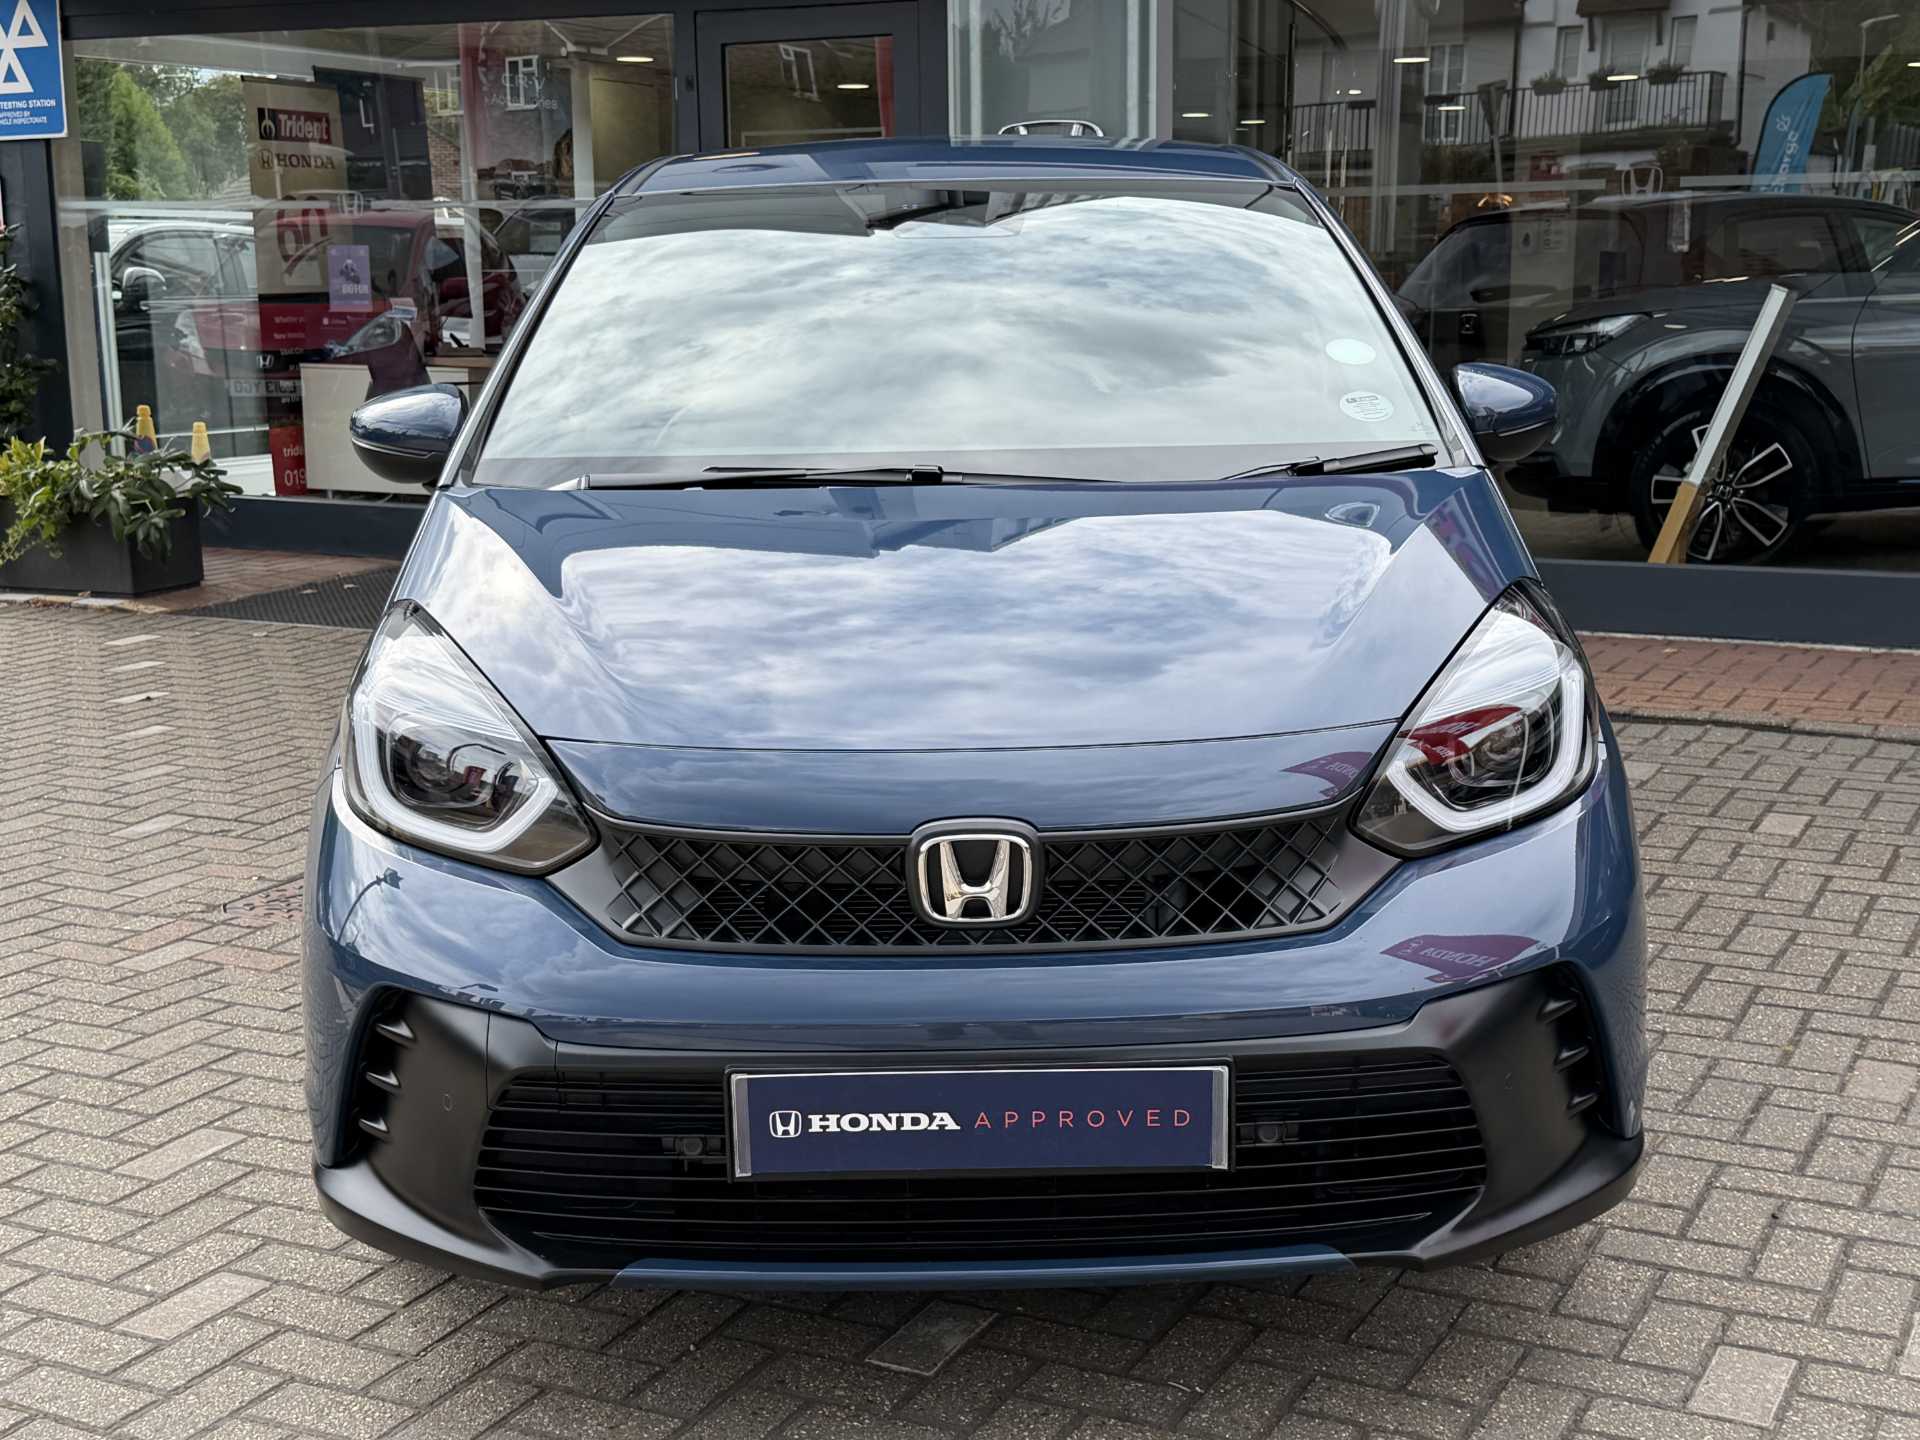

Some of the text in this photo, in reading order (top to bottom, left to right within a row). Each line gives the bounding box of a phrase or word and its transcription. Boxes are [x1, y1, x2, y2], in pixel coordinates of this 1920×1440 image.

[28, 99, 56, 108] STATION
[278, 114, 329, 140] Trident
[275, 152, 336, 170] HONDA
[808, 1112, 961, 1132] HONDA
[974, 1109, 1191, 1128] APPROVED
